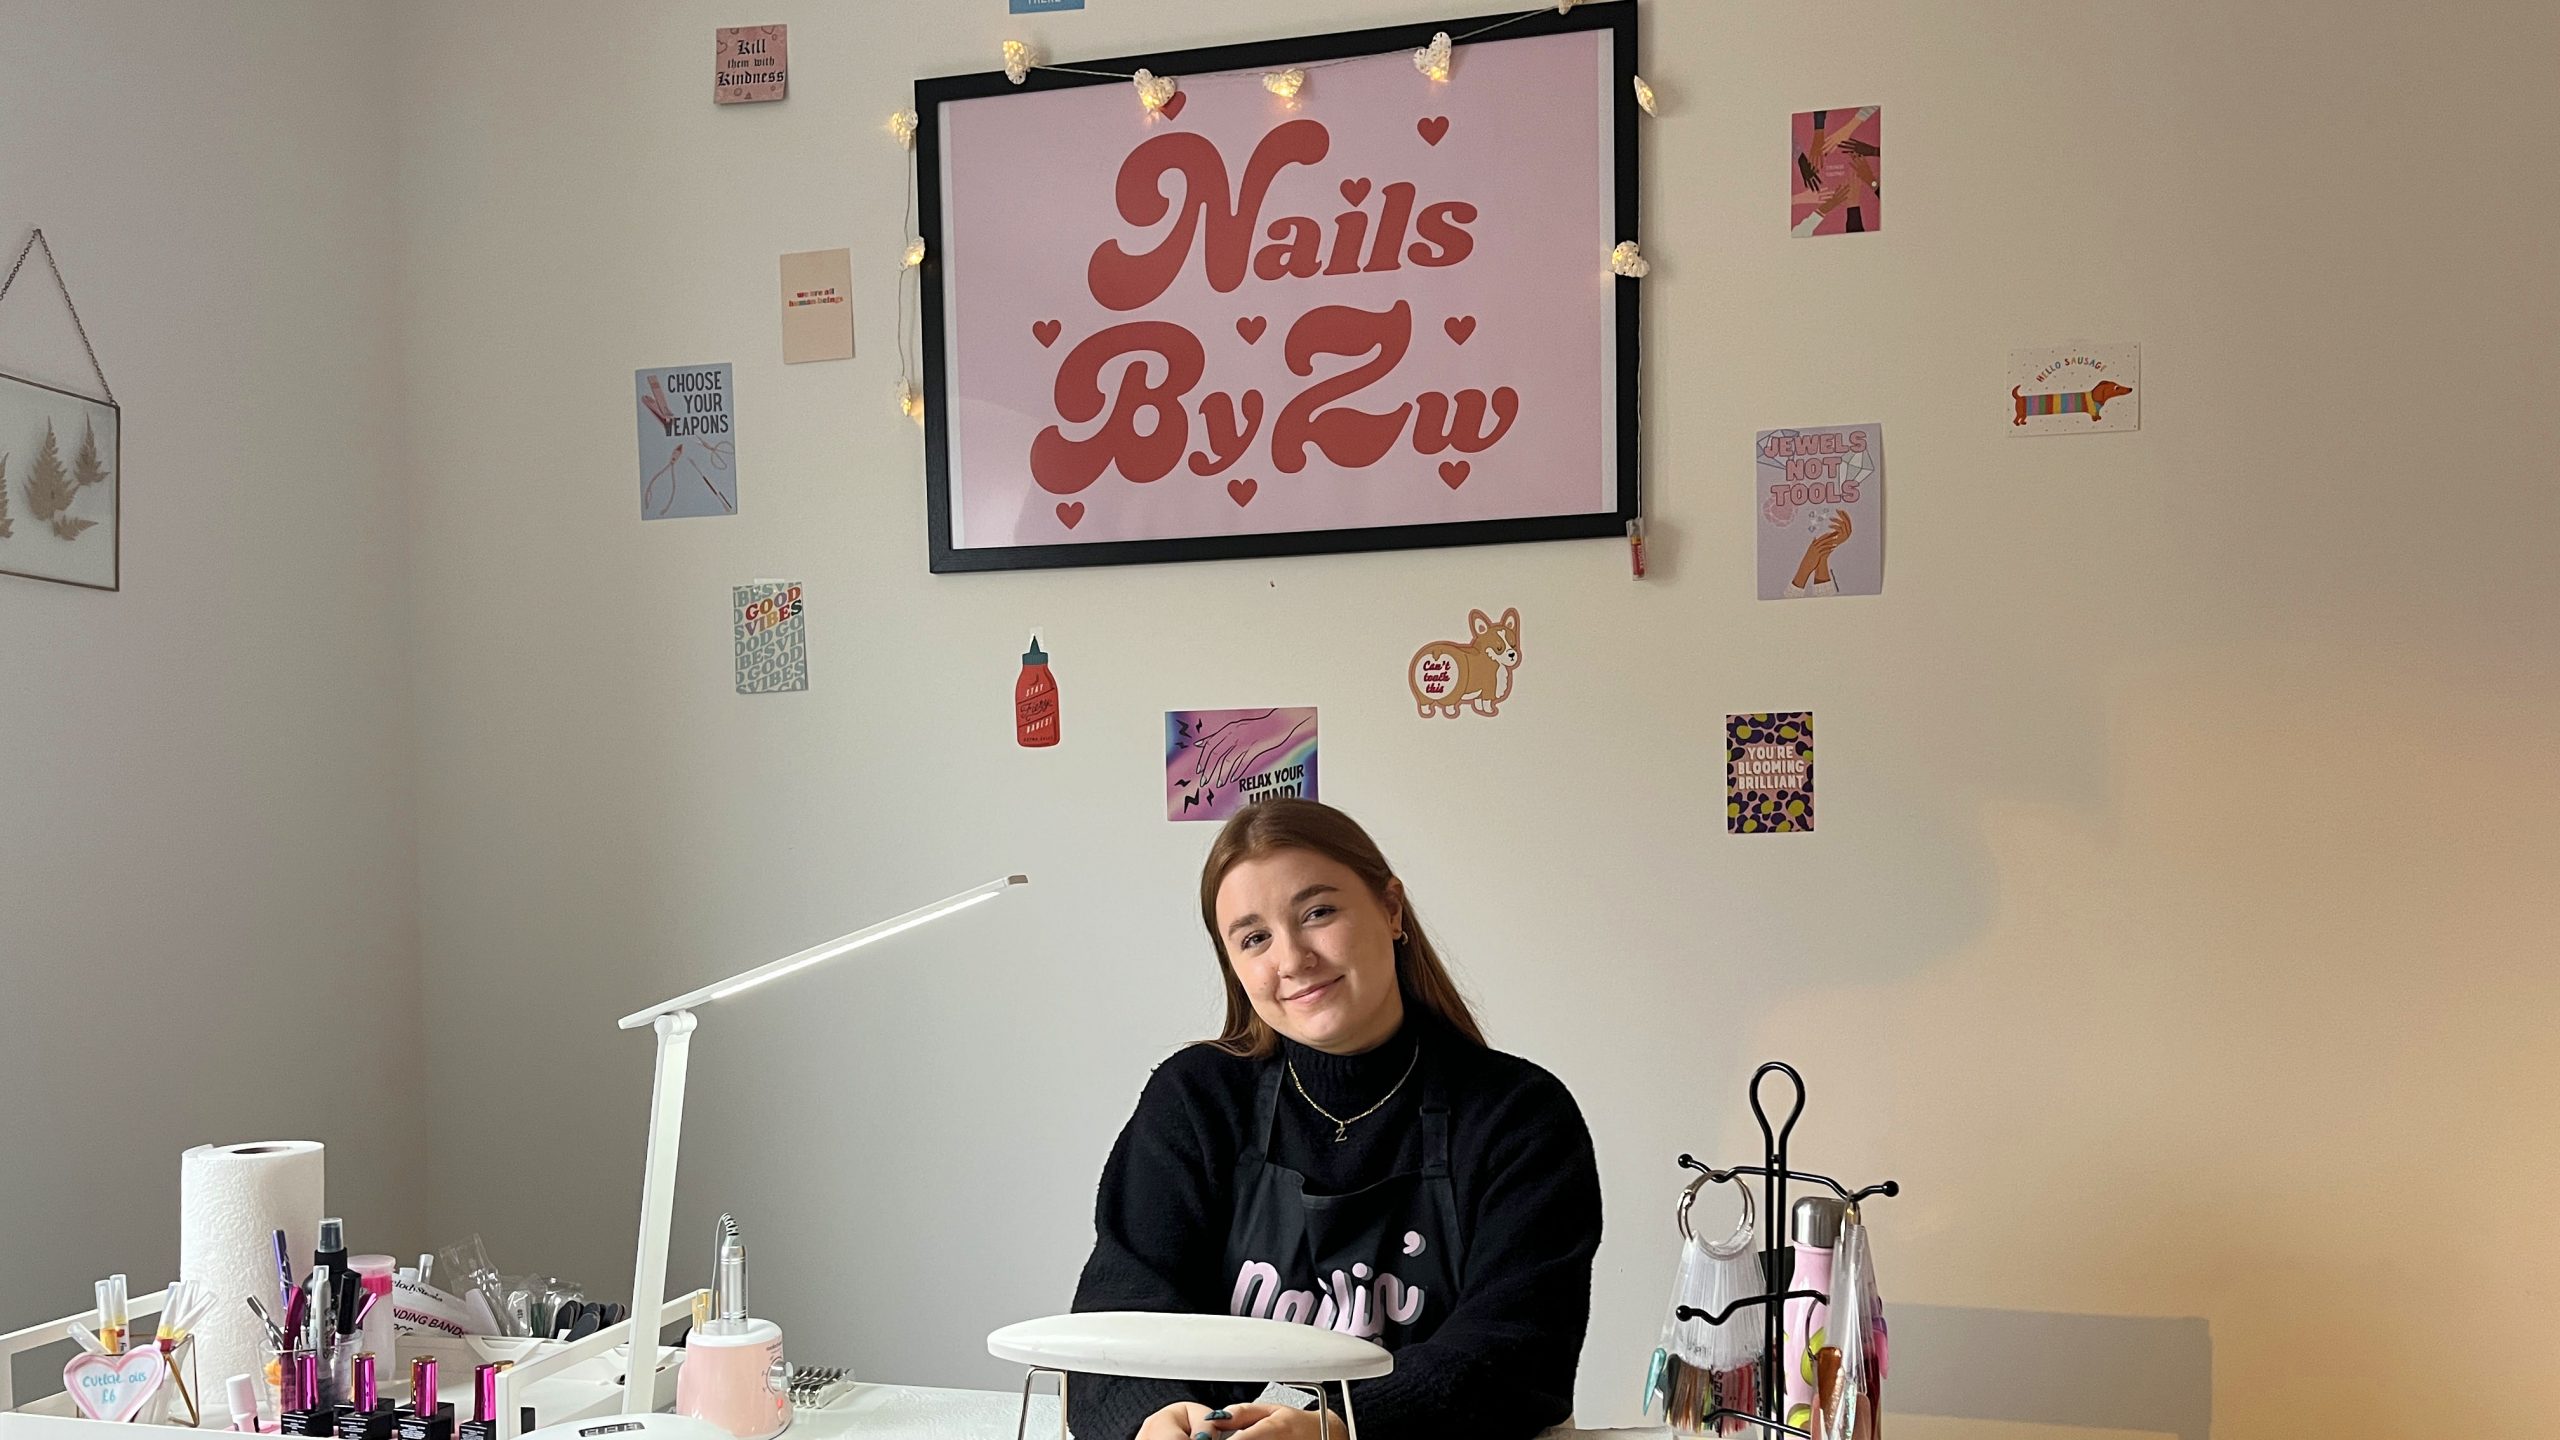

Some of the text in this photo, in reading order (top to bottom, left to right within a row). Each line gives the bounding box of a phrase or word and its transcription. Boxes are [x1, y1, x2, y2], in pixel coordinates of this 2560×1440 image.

[737, 39, 766, 55] Kill
[727, 56, 775, 70] them with
[717, 70, 785, 87] Kindness
[1087, 118, 1478, 311] Nails
[668, 371, 722, 393] CHOOSE
[2035, 361, 2061, 382] HELLO
[683, 393, 722, 414] YOUR
[1764, 430, 1867, 458] JEWELS
[1786, 456, 1842, 481] NOT
[1770, 480, 1861, 506] TOOLS
[746, 587, 801, 620] GOOD
[745, 599, 802, 636] VIBES
[748, 646, 802, 681] GOOD
[1423, 660, 1451, 671] Can't
[1426, 683, 1444, 693] this
[1747, 746, 1794, 760] YOU'RE
[1239, 764, 1304, 792] RELAX YOUR
[1738, 760, 1805, 775] BLOOMING
[1738, 775, 1805, 790] BRILLIANT
